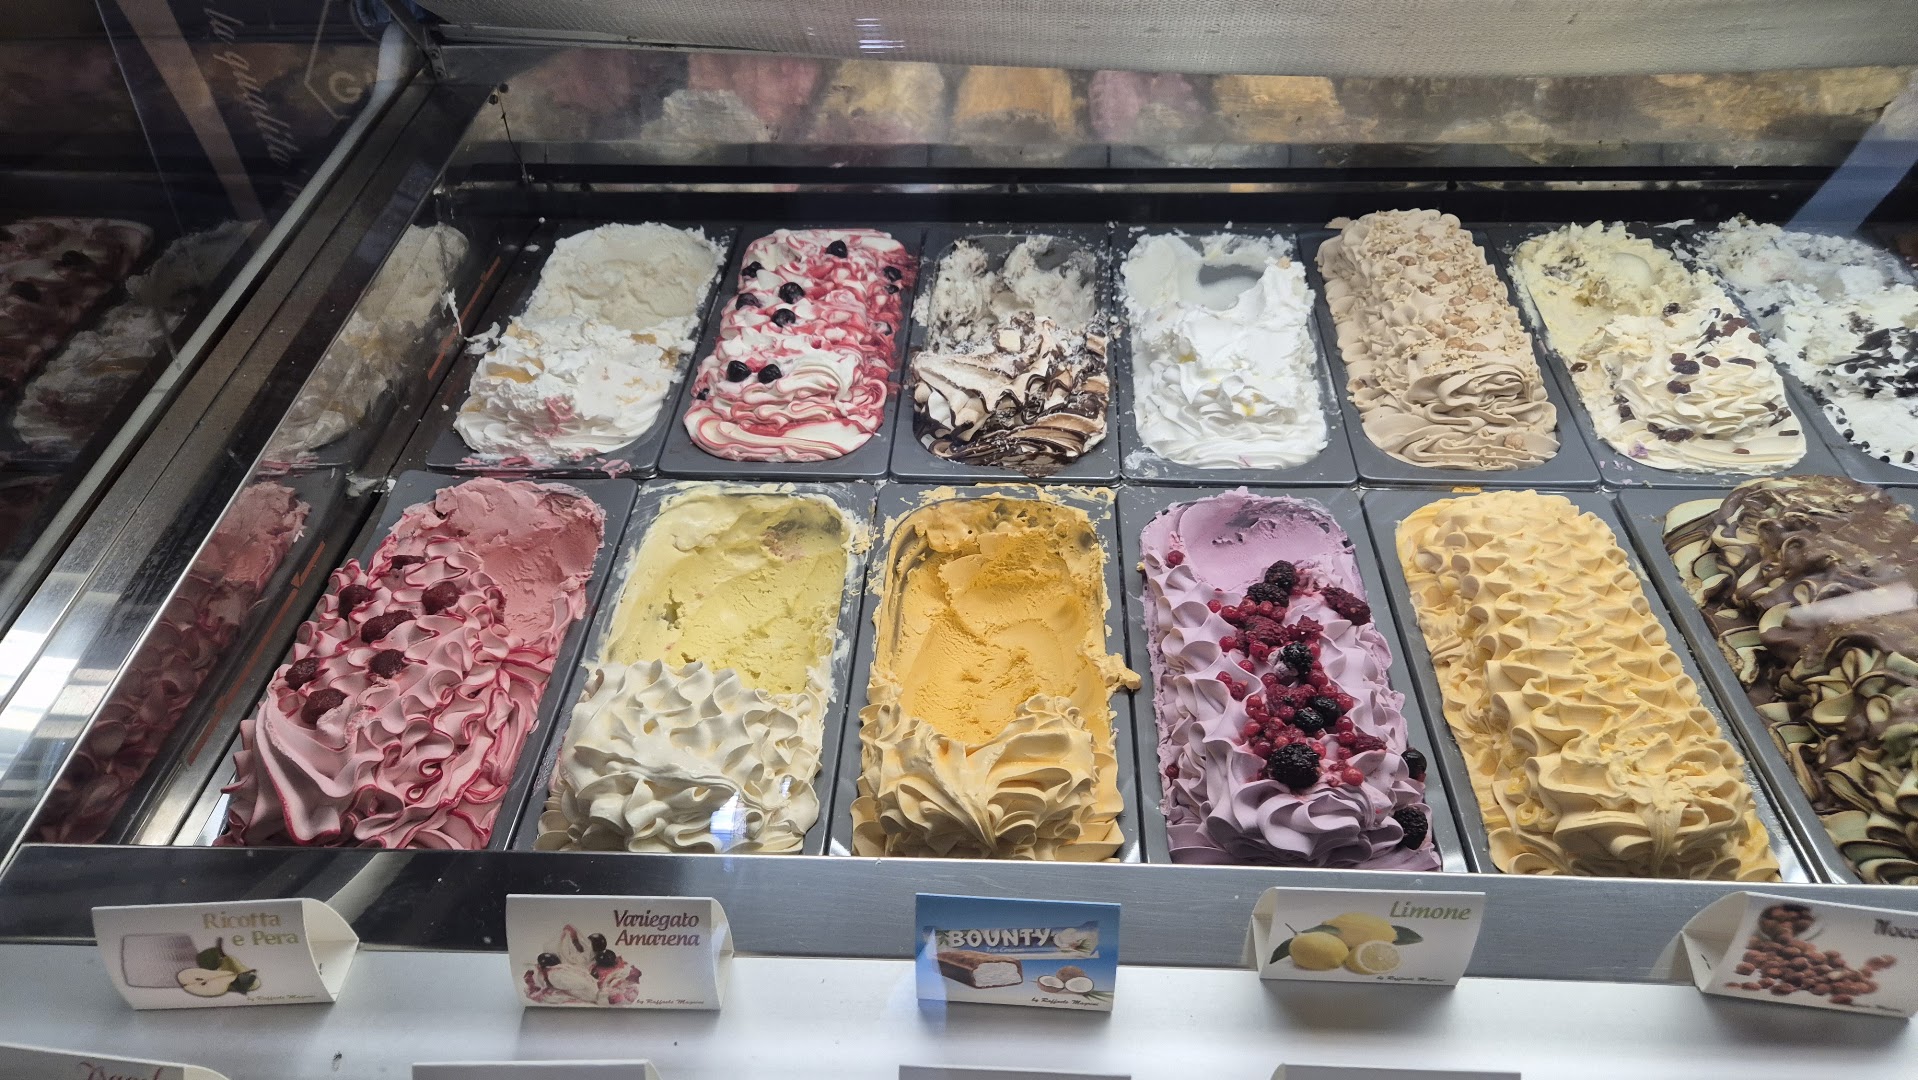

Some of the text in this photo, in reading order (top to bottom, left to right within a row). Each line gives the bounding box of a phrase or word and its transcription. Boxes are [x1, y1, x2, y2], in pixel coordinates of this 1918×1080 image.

[1389, 900, 1472, 920] Limone
[203, 911, 281, 929] Ricotta
[613, 909, 700, 931] Variegato
[231, 930, 299, 946] e Pera
[614, 929, 700, 946] Amarena
[950, 928, 1051, 948] BOUNTY
